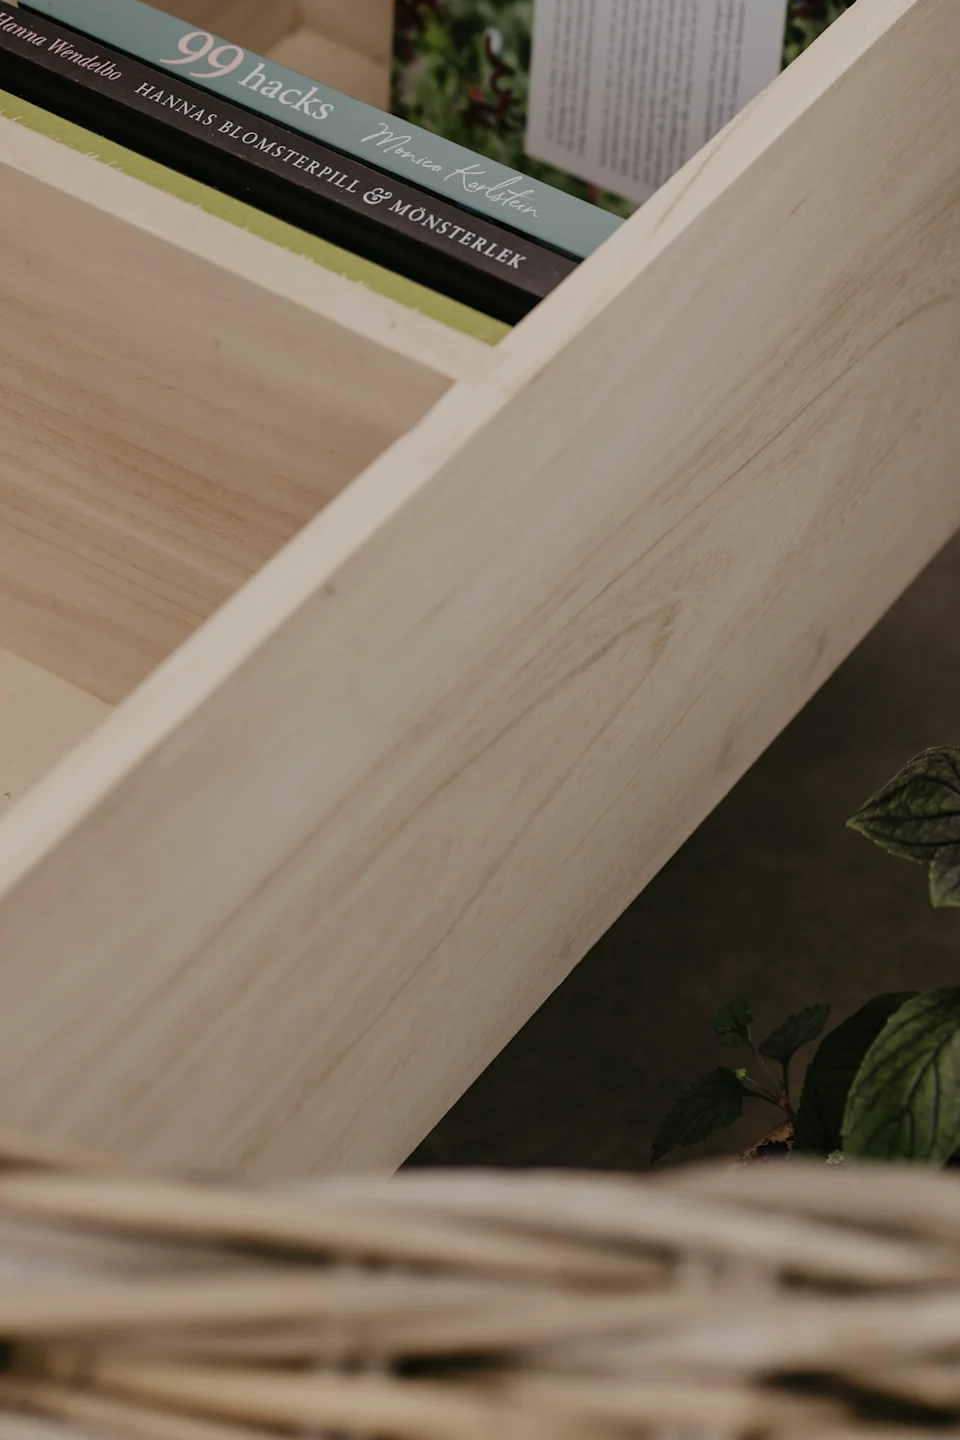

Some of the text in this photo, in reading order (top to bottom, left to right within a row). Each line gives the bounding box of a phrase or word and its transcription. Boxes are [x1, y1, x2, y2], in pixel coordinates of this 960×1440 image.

[0, 12, 528, 270] Hanna Wendelbo HANNAS BLOMSTERPILL & MÖNSTERLEK
[159, 30, 540, 219] 99 hacks Monica Karlstein
